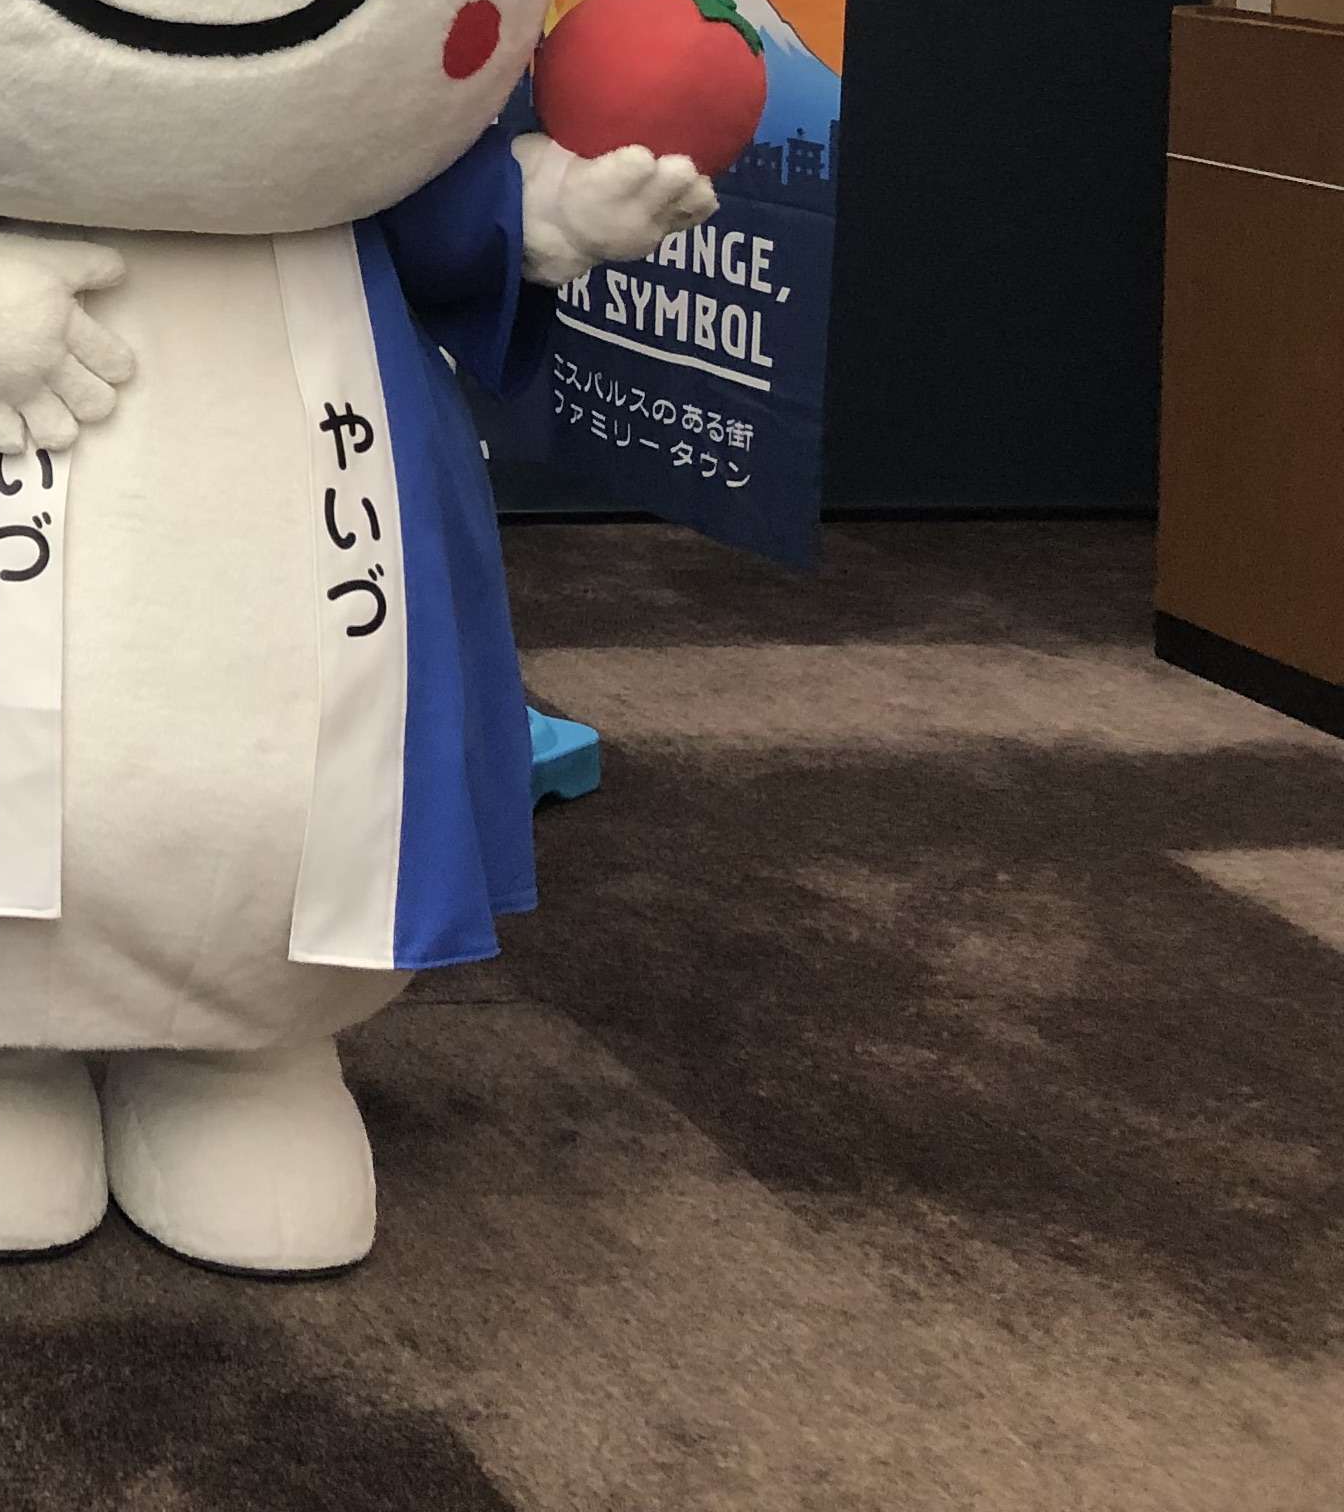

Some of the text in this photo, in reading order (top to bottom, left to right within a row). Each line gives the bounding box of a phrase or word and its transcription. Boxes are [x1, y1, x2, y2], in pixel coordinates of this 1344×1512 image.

[605, 269, 774, 368] SYMBOL
[318, 401, 387, 638] やいづ
